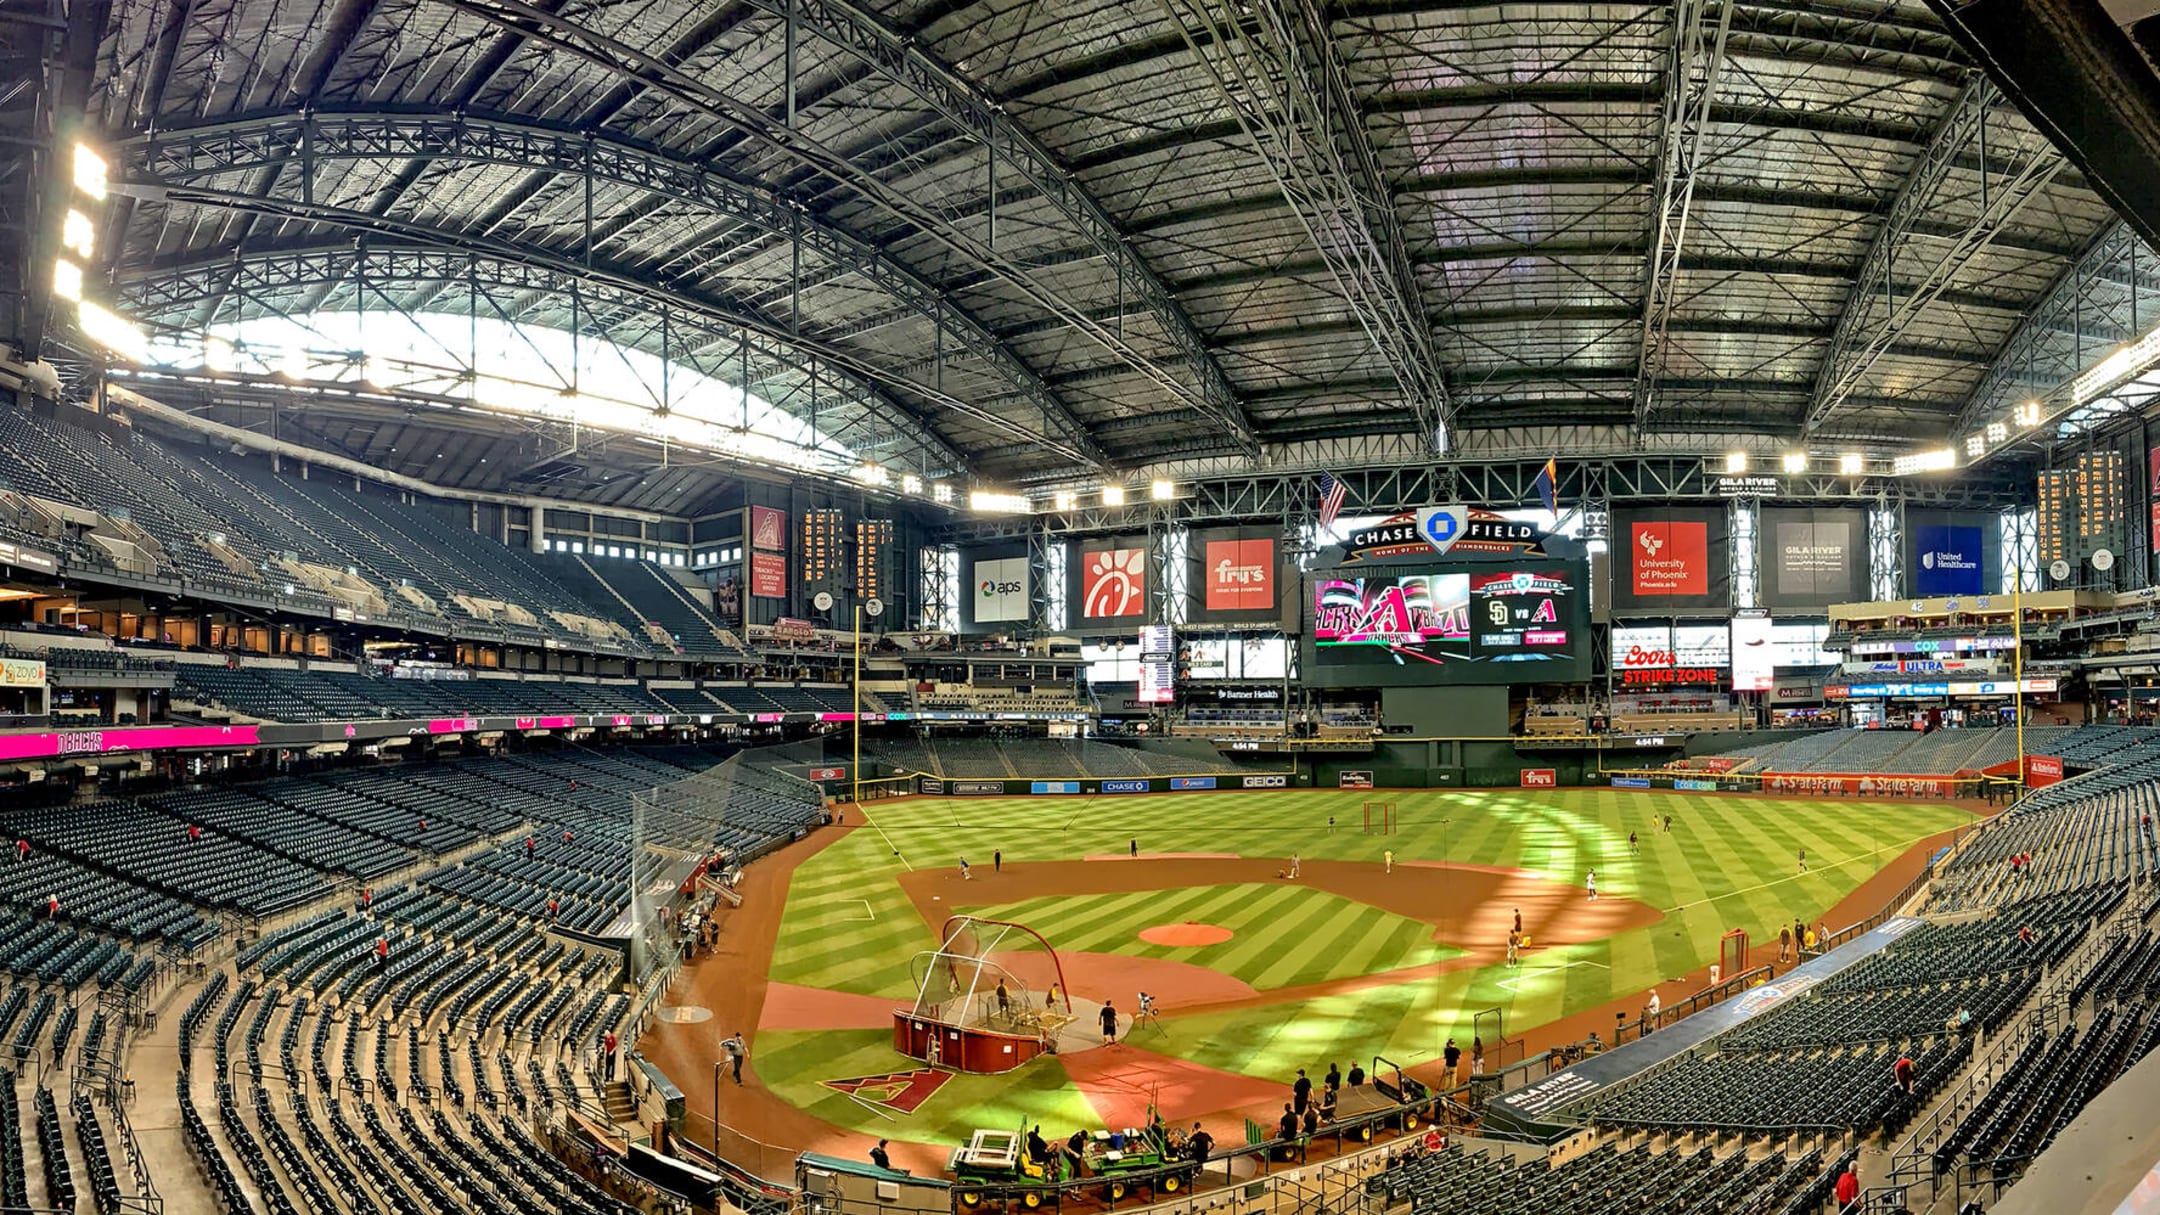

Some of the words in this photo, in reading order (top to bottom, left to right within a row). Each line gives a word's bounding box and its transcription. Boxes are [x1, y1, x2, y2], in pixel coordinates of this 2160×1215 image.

[1720, 478, 1743, 486] GILA
[1745, 478, 1776, 486] RIVER
[1354, 527, 1414, 546] CHASE
[1472, 524, 1532, 538] FIELD
[1455, 543, 1510, 552] DIAMONDBACKS
[1785, 546, 1809, 554] GILA
[1811, 546, 1841, 554] RIVER
[1937, 552, 1962, 561] United
[1640, 559, 1685, 570] University
[1937, 560, 1976, 568] Healthcare
[1214, 559, 1266, 584] fry's
[1640, 570, 1650, 579] of
[1651, 570, 1688, 579] Phoenix
[997, 581, 1021, 596] aps
[1488, 583, 1512, 591] CHASE
[1911, 601, 1923, 613] 42
[1915, 640, 1940, 652] COX
[1624, 645, 1677, 666] Coors
[1906, 661, 1943, 672] ULTRA
[1623, 669, 1675, 684] STRIKE
[1677, 668, 1717, 683] ZONE
[1227, 690, 1253, 698] Banner
[1254, 690, 1278, 698] Health
[888, 712, 906, 720] COX
[1232, 742, 1247, 750] 4:54
[1247, 742, 1259, 750] PM
[1635, 738, 1651, 746] 4:54
[1652, 737, 1664, 745] PM
[1107, 782, 1135, 791] CHASE
[1243, 776, 1286, 788] GEICO
